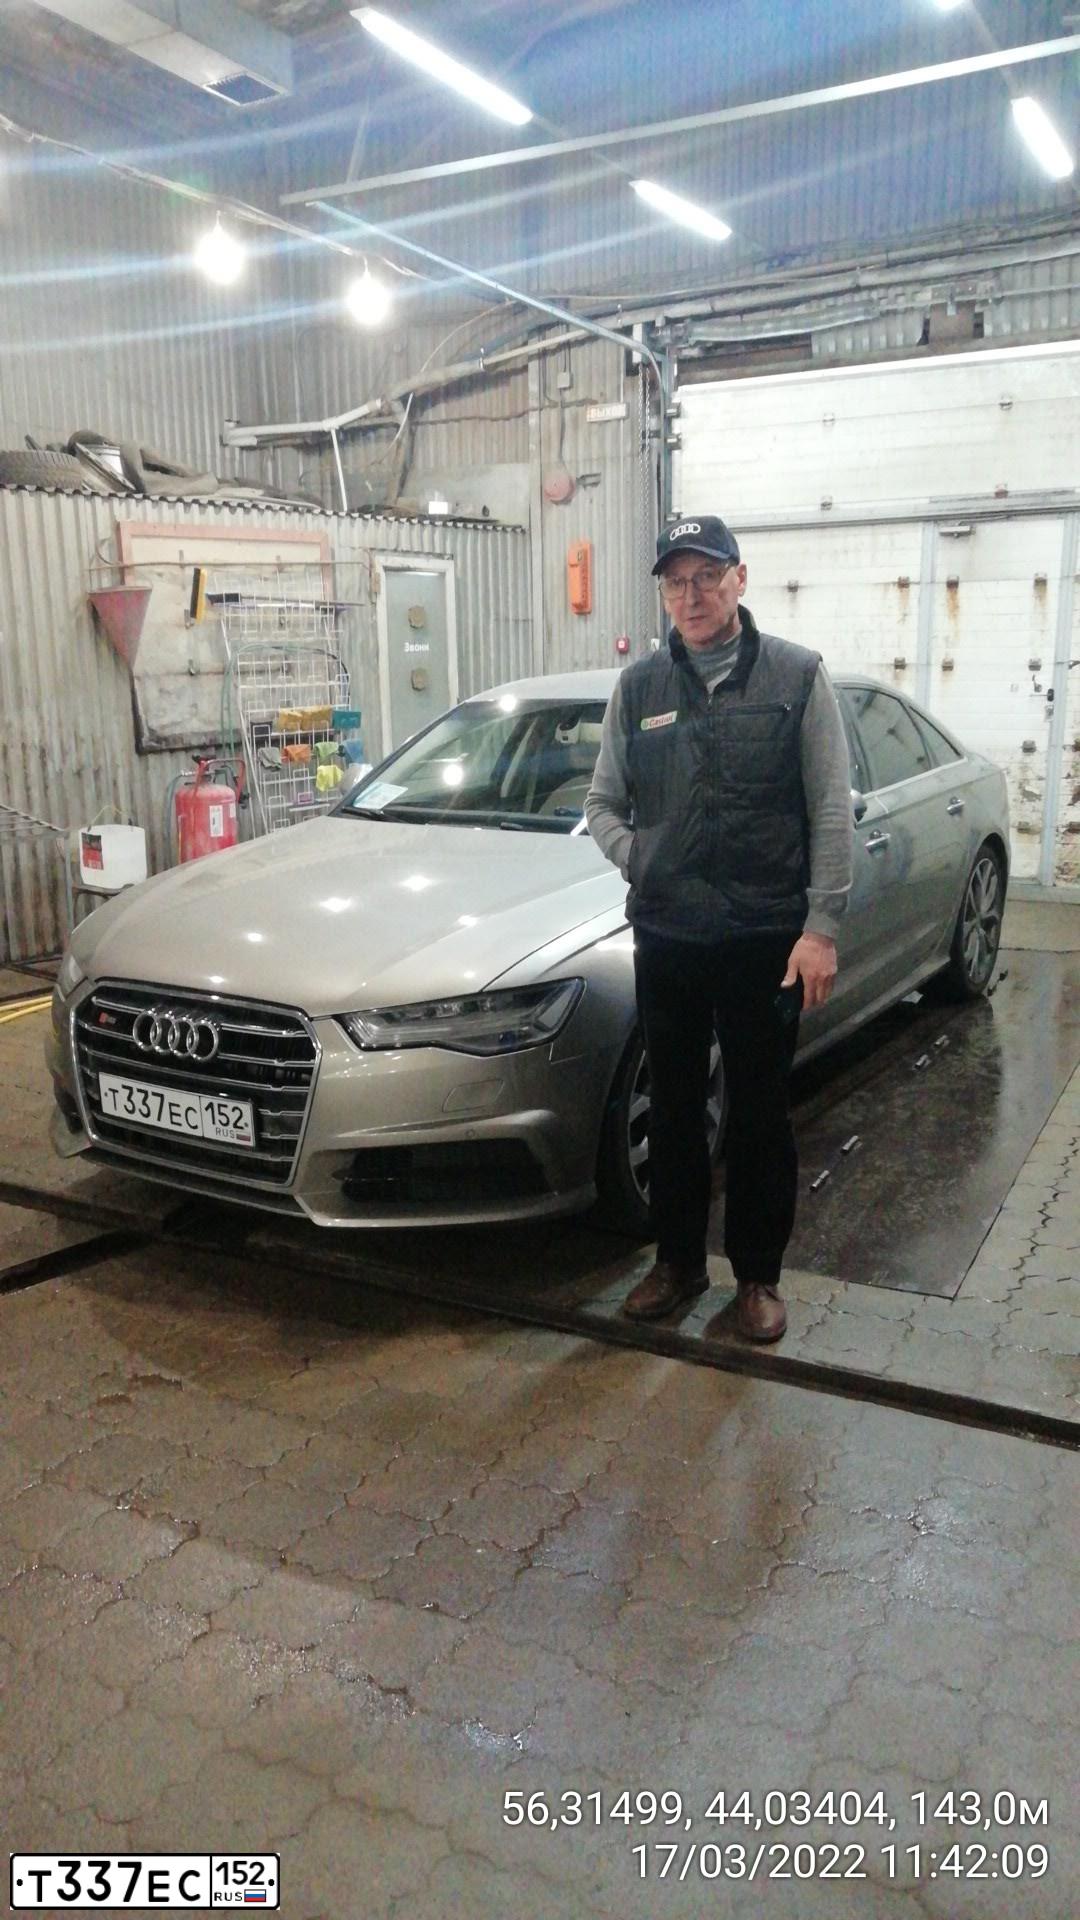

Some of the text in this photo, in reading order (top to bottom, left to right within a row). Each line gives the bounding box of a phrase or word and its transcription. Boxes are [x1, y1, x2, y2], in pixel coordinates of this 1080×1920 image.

[108, 1085, 244, 1130] Т337ЕС 152
[215, 1127, 235, 1138] RUS
